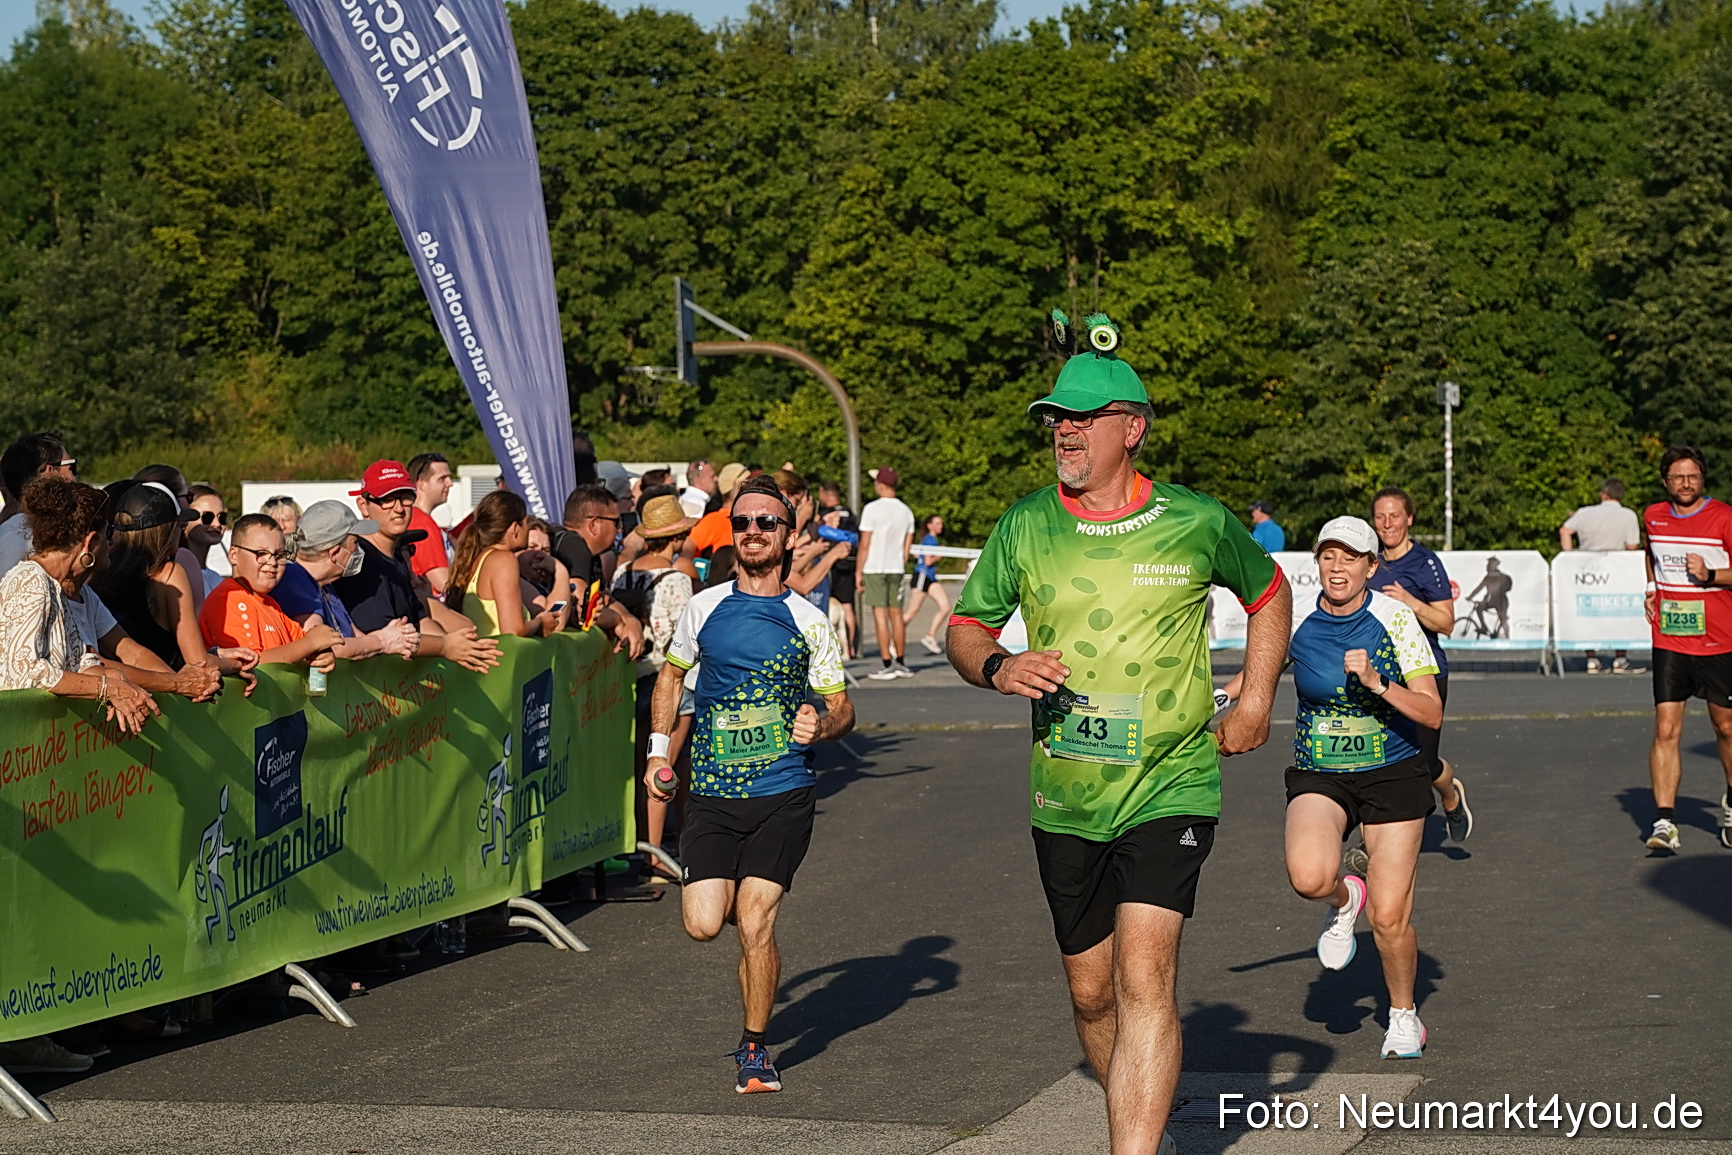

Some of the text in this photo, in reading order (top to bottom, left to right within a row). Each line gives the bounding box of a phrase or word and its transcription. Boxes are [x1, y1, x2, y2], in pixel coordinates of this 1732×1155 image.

[1132, 563, 1191, 576] TRENDHAUS
[1575, 572, 1609, 585] NOW
[1132, 577, 1190, 586] POWER-TEAM
[1667, 612, 1698, 625] 1238
[728, 726, 766, 747] 703
[772, 723, 785, 750] 2022
[1076, 716, 1108, 741] 43
[715, 735, 725, 755] RUN
[749, 743, 771, 753] Aaron
[1061, 735, 1127, 751] Ruckdeschel Thomas
[1126, 723, 1138, 756] 2022
[1315, 740, 1324, 759] RUN
[1328, 735, 1366, 753] 720
[1372, 734, 1382, 759] 2022
[0, 718, 68, 789] esunde
[266, 750, 297, 779] Fischer
[22, 745, 155, 841] laufen länger!
[232, 784, 348, 904] firmenlauf
[1179, 838, 1198, 847] adidas
[239, 884, 287, 931] neumarkt
[314, 865, 456, 936] www.firmenlauf-oberpfalz.de
